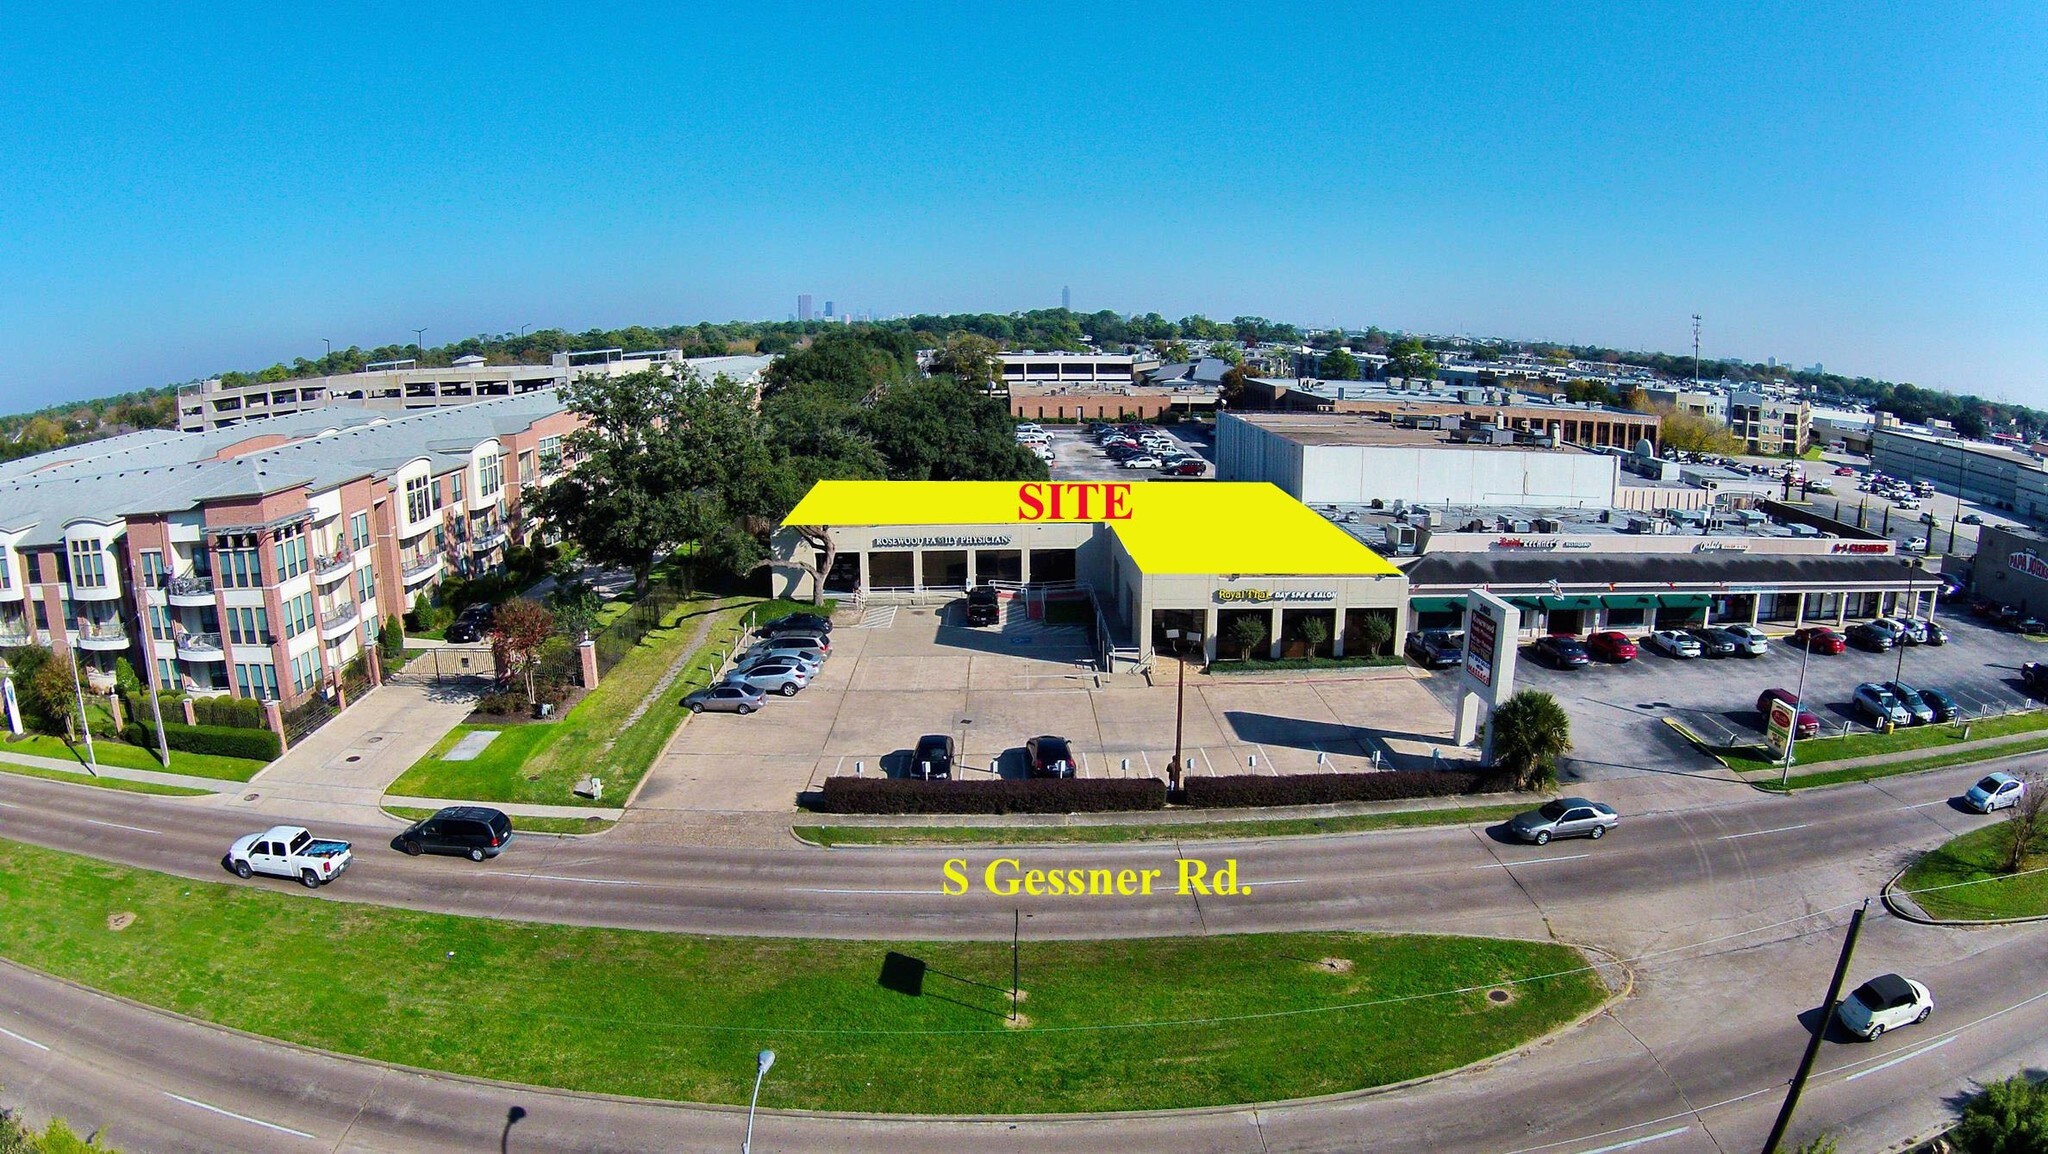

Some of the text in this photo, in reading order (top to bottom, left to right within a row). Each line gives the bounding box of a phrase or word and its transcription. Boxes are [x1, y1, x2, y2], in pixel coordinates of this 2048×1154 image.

[876, 537, 923, 546] ROSEWOOD
[960, 535, 1012, 545] PHYSICIANS
[1219, 589, 1245, 601] Royal
[1313, 591, 1338, 599] SALON
